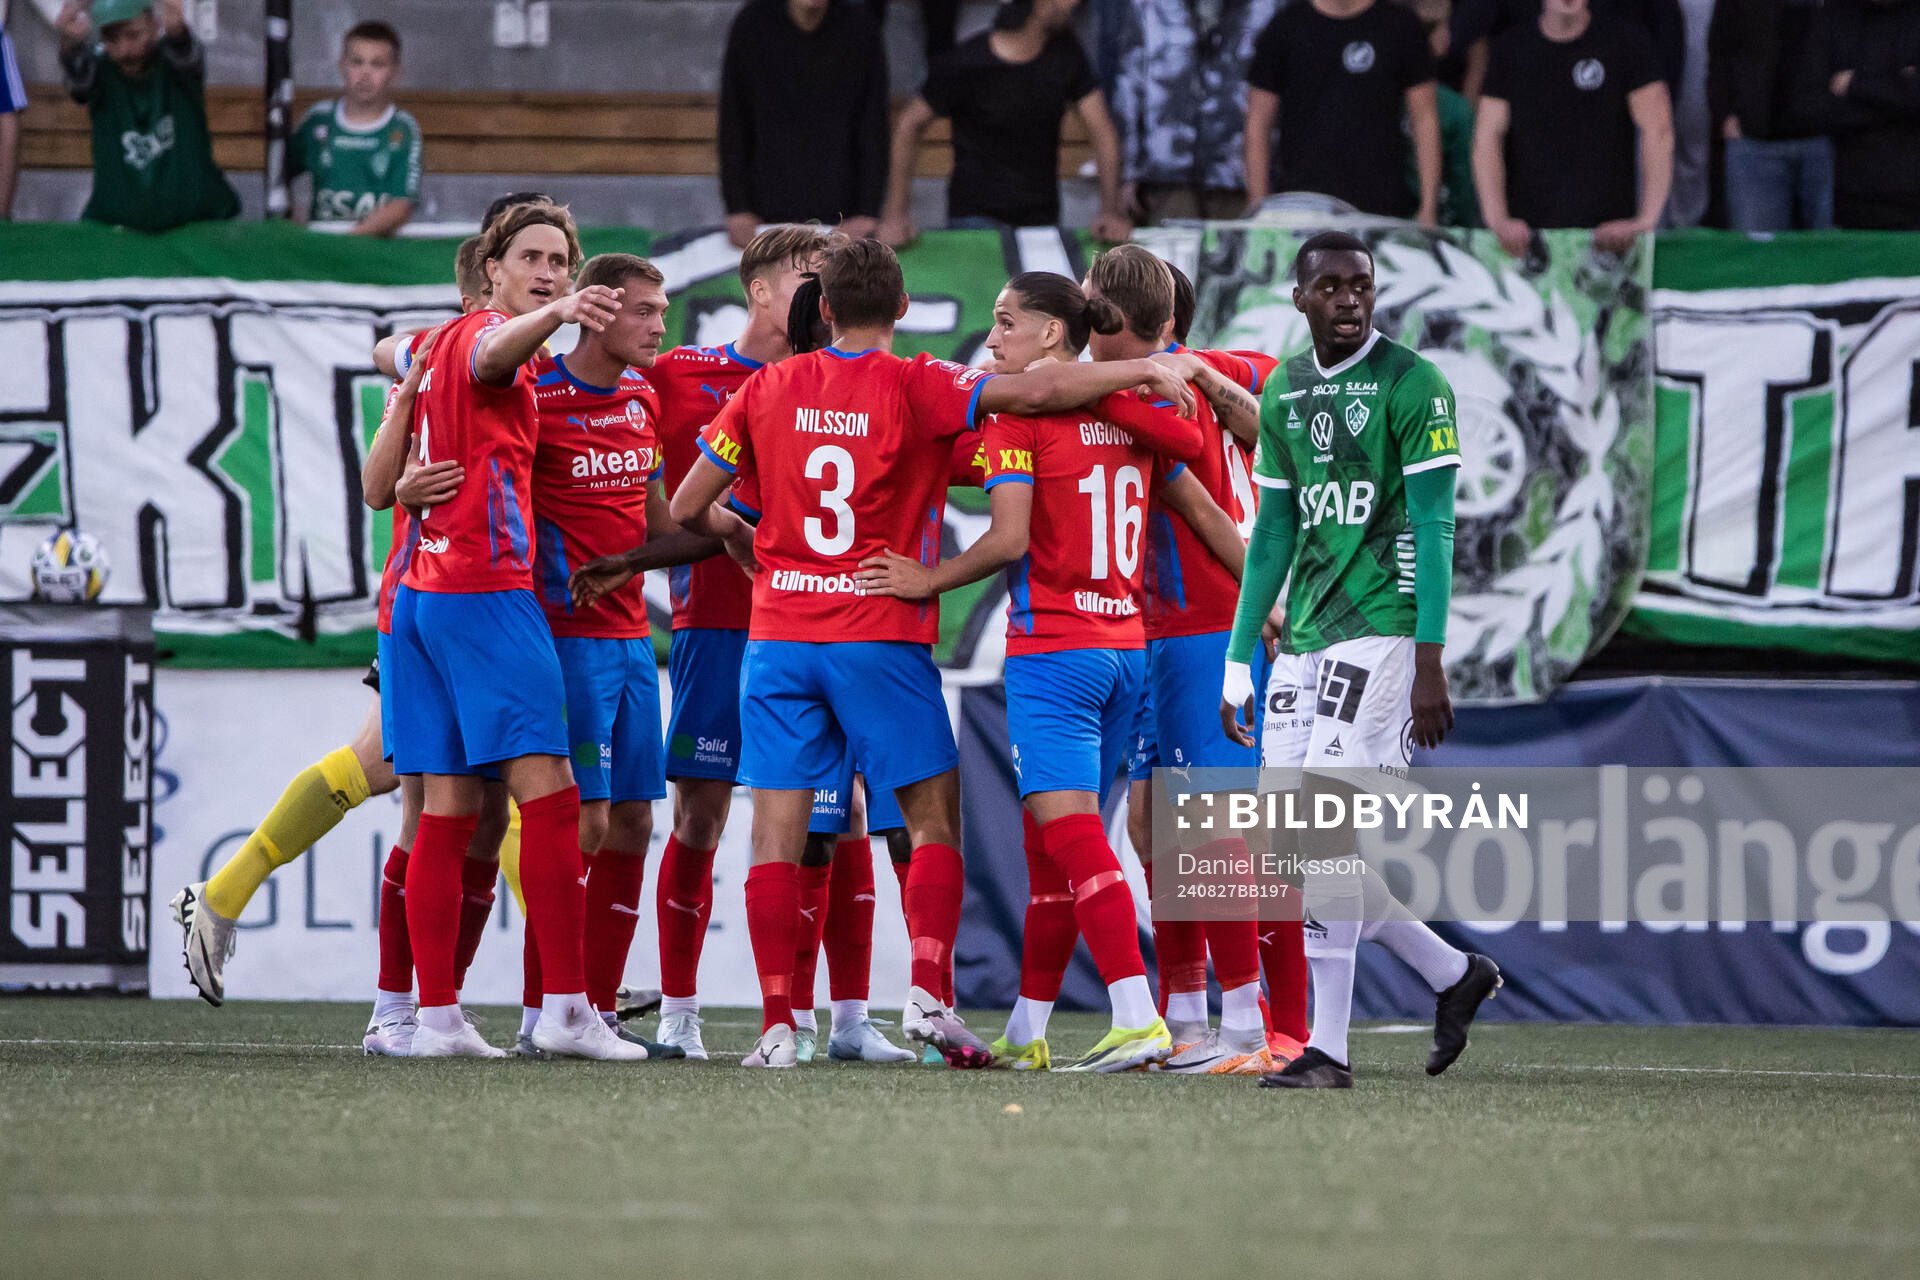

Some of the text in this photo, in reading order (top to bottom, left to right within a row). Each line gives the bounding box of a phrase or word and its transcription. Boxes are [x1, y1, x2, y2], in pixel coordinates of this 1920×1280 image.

[795, 407, 869, 437] NILSSON
[571, 447, 639, 478] akea
[709, 428, 742, 466] XXL
[804, 445, 856, 557] 3
[1078, 464, 1145, 580] 16
[696, 736, 729, 753] Solid
[1174, 748, 1184, 763] 9
[11, 649, 87, 949] SELECT
[121, 653, 151, 952] SELECT
[813, 789, 837, 804] olid
